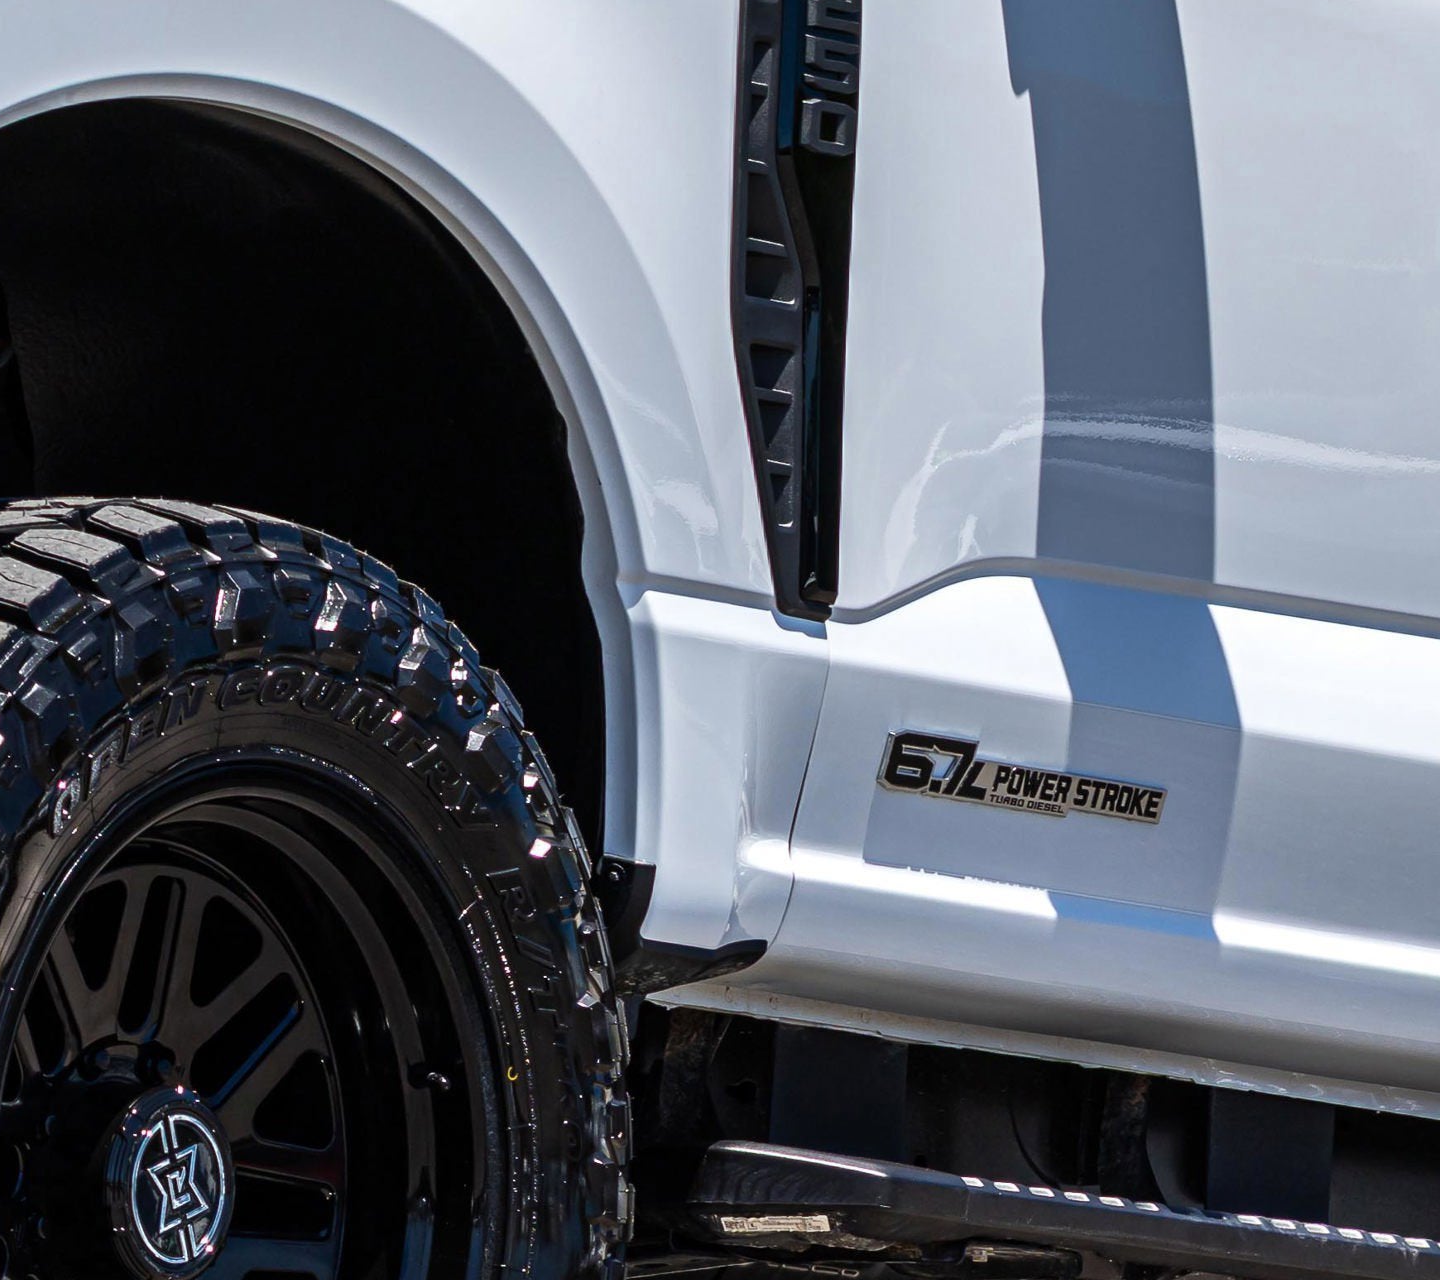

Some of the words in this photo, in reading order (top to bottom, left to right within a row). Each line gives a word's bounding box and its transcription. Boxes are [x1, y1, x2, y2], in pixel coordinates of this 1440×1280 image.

[51, 682, 210, 838] OPEN
[219, 660, 502, 828] COUNTRY
[877, 730, 988, 801] 6.7L
[991, 765, 1072, 804] POWER
[1073, 779, 1164, 819] STROKE
[990, 794, 1025, 808] TURBO
[1026, 801, 1064, 814] DIESEL
